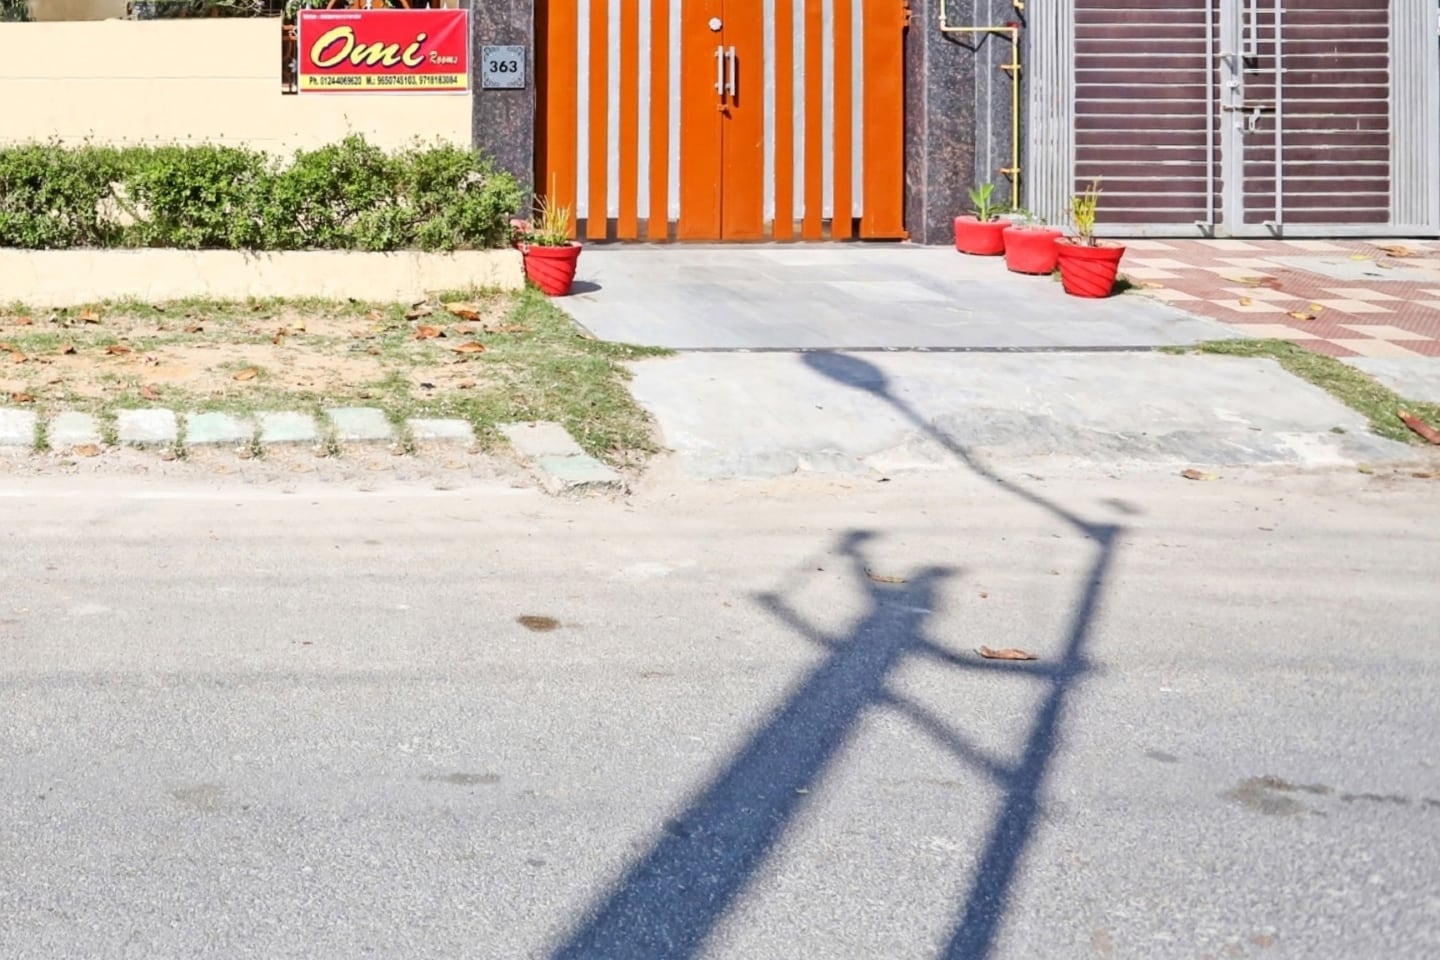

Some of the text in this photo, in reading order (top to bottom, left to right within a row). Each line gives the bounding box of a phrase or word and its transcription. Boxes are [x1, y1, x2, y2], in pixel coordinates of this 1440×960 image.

[310, 25, 458, 68] Omi Rooms
[489, 60, 517, 73] 363
